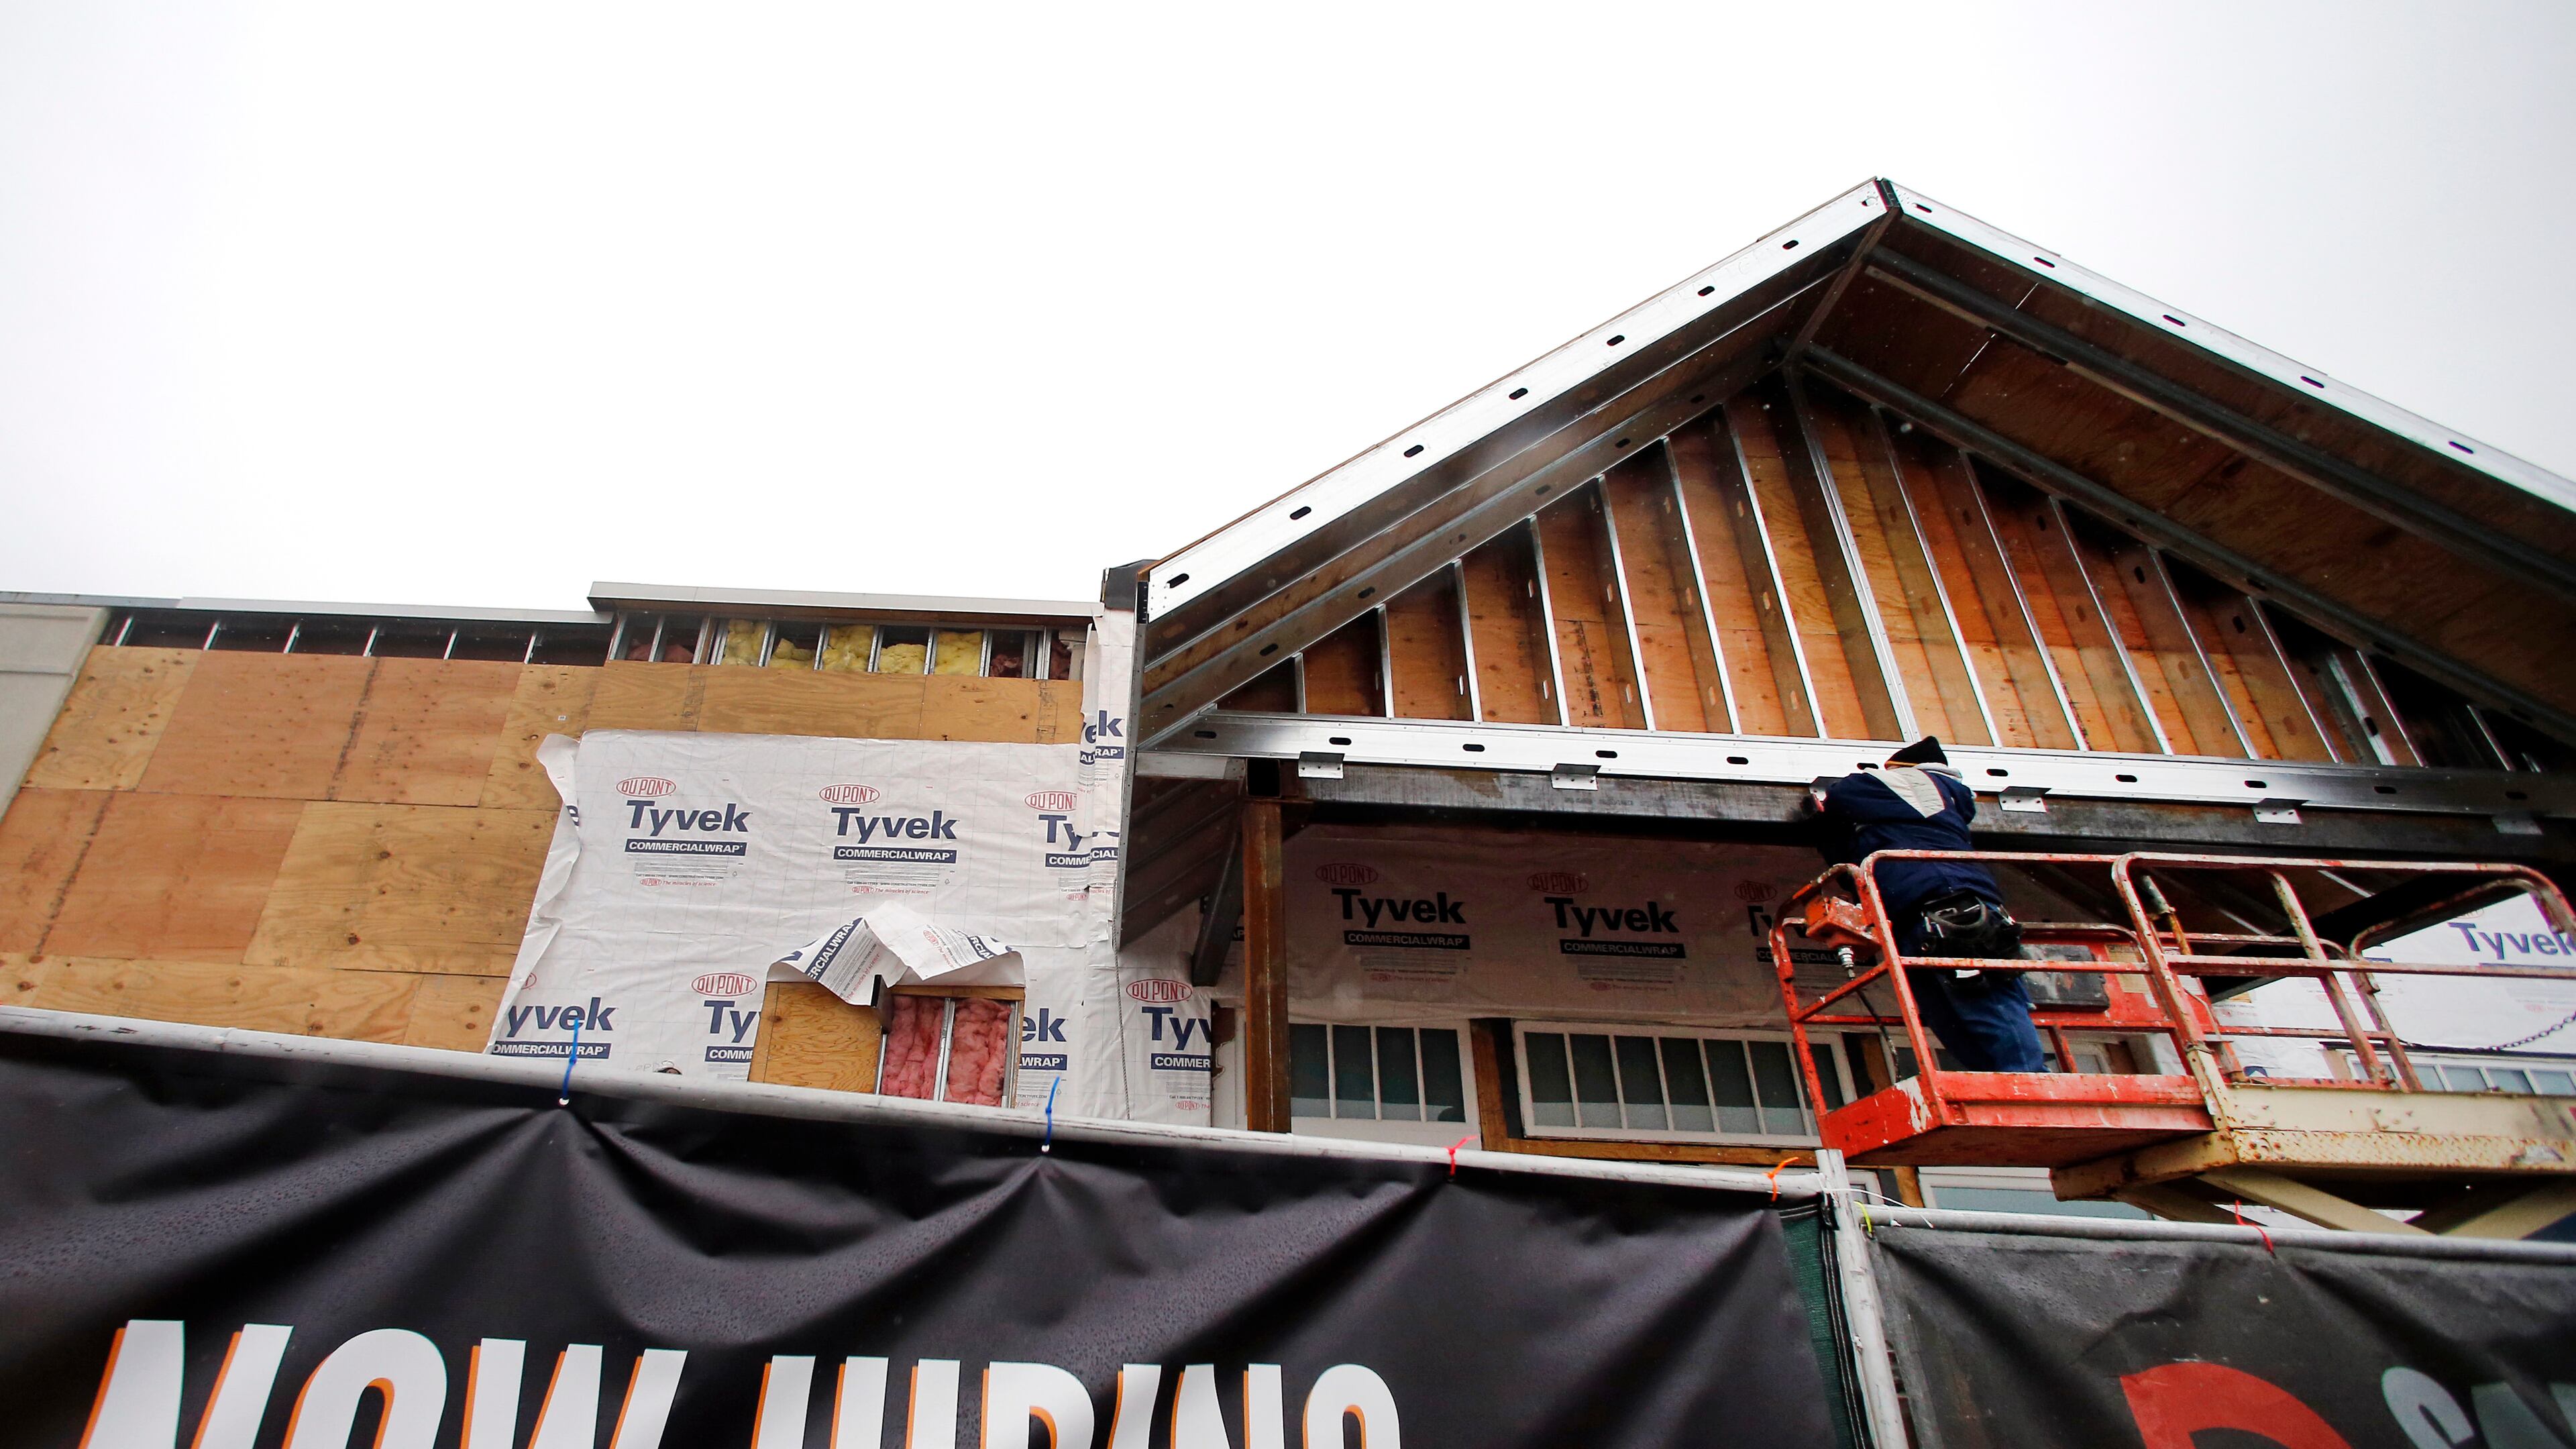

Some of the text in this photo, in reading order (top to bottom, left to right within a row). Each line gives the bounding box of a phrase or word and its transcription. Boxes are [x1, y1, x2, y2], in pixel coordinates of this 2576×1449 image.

[1081, 710, 1123, 744] ek
[627, 800, 752, 837] Tyvek
[831, 807, 957, 844] Tyvek
[629, 841, 740, 853] COMMERCIALWRAP
[837, 849, 950, 861] COMMERCIALWRAP
[1049, 850, 1118, 865] COMMECIAL
[1332, 888, 1466, 928] Tyvek
[1544, 897, 1679, 936] Tyvek
[1348, 933, 1463, 947] COMMERCIALWRAP
[1564, 942, 1678, 955] COMMERCIALWRAP
[704, 1000, 761, 1043] Ty
[1019, 1057, 1061, 1067] WRAP
